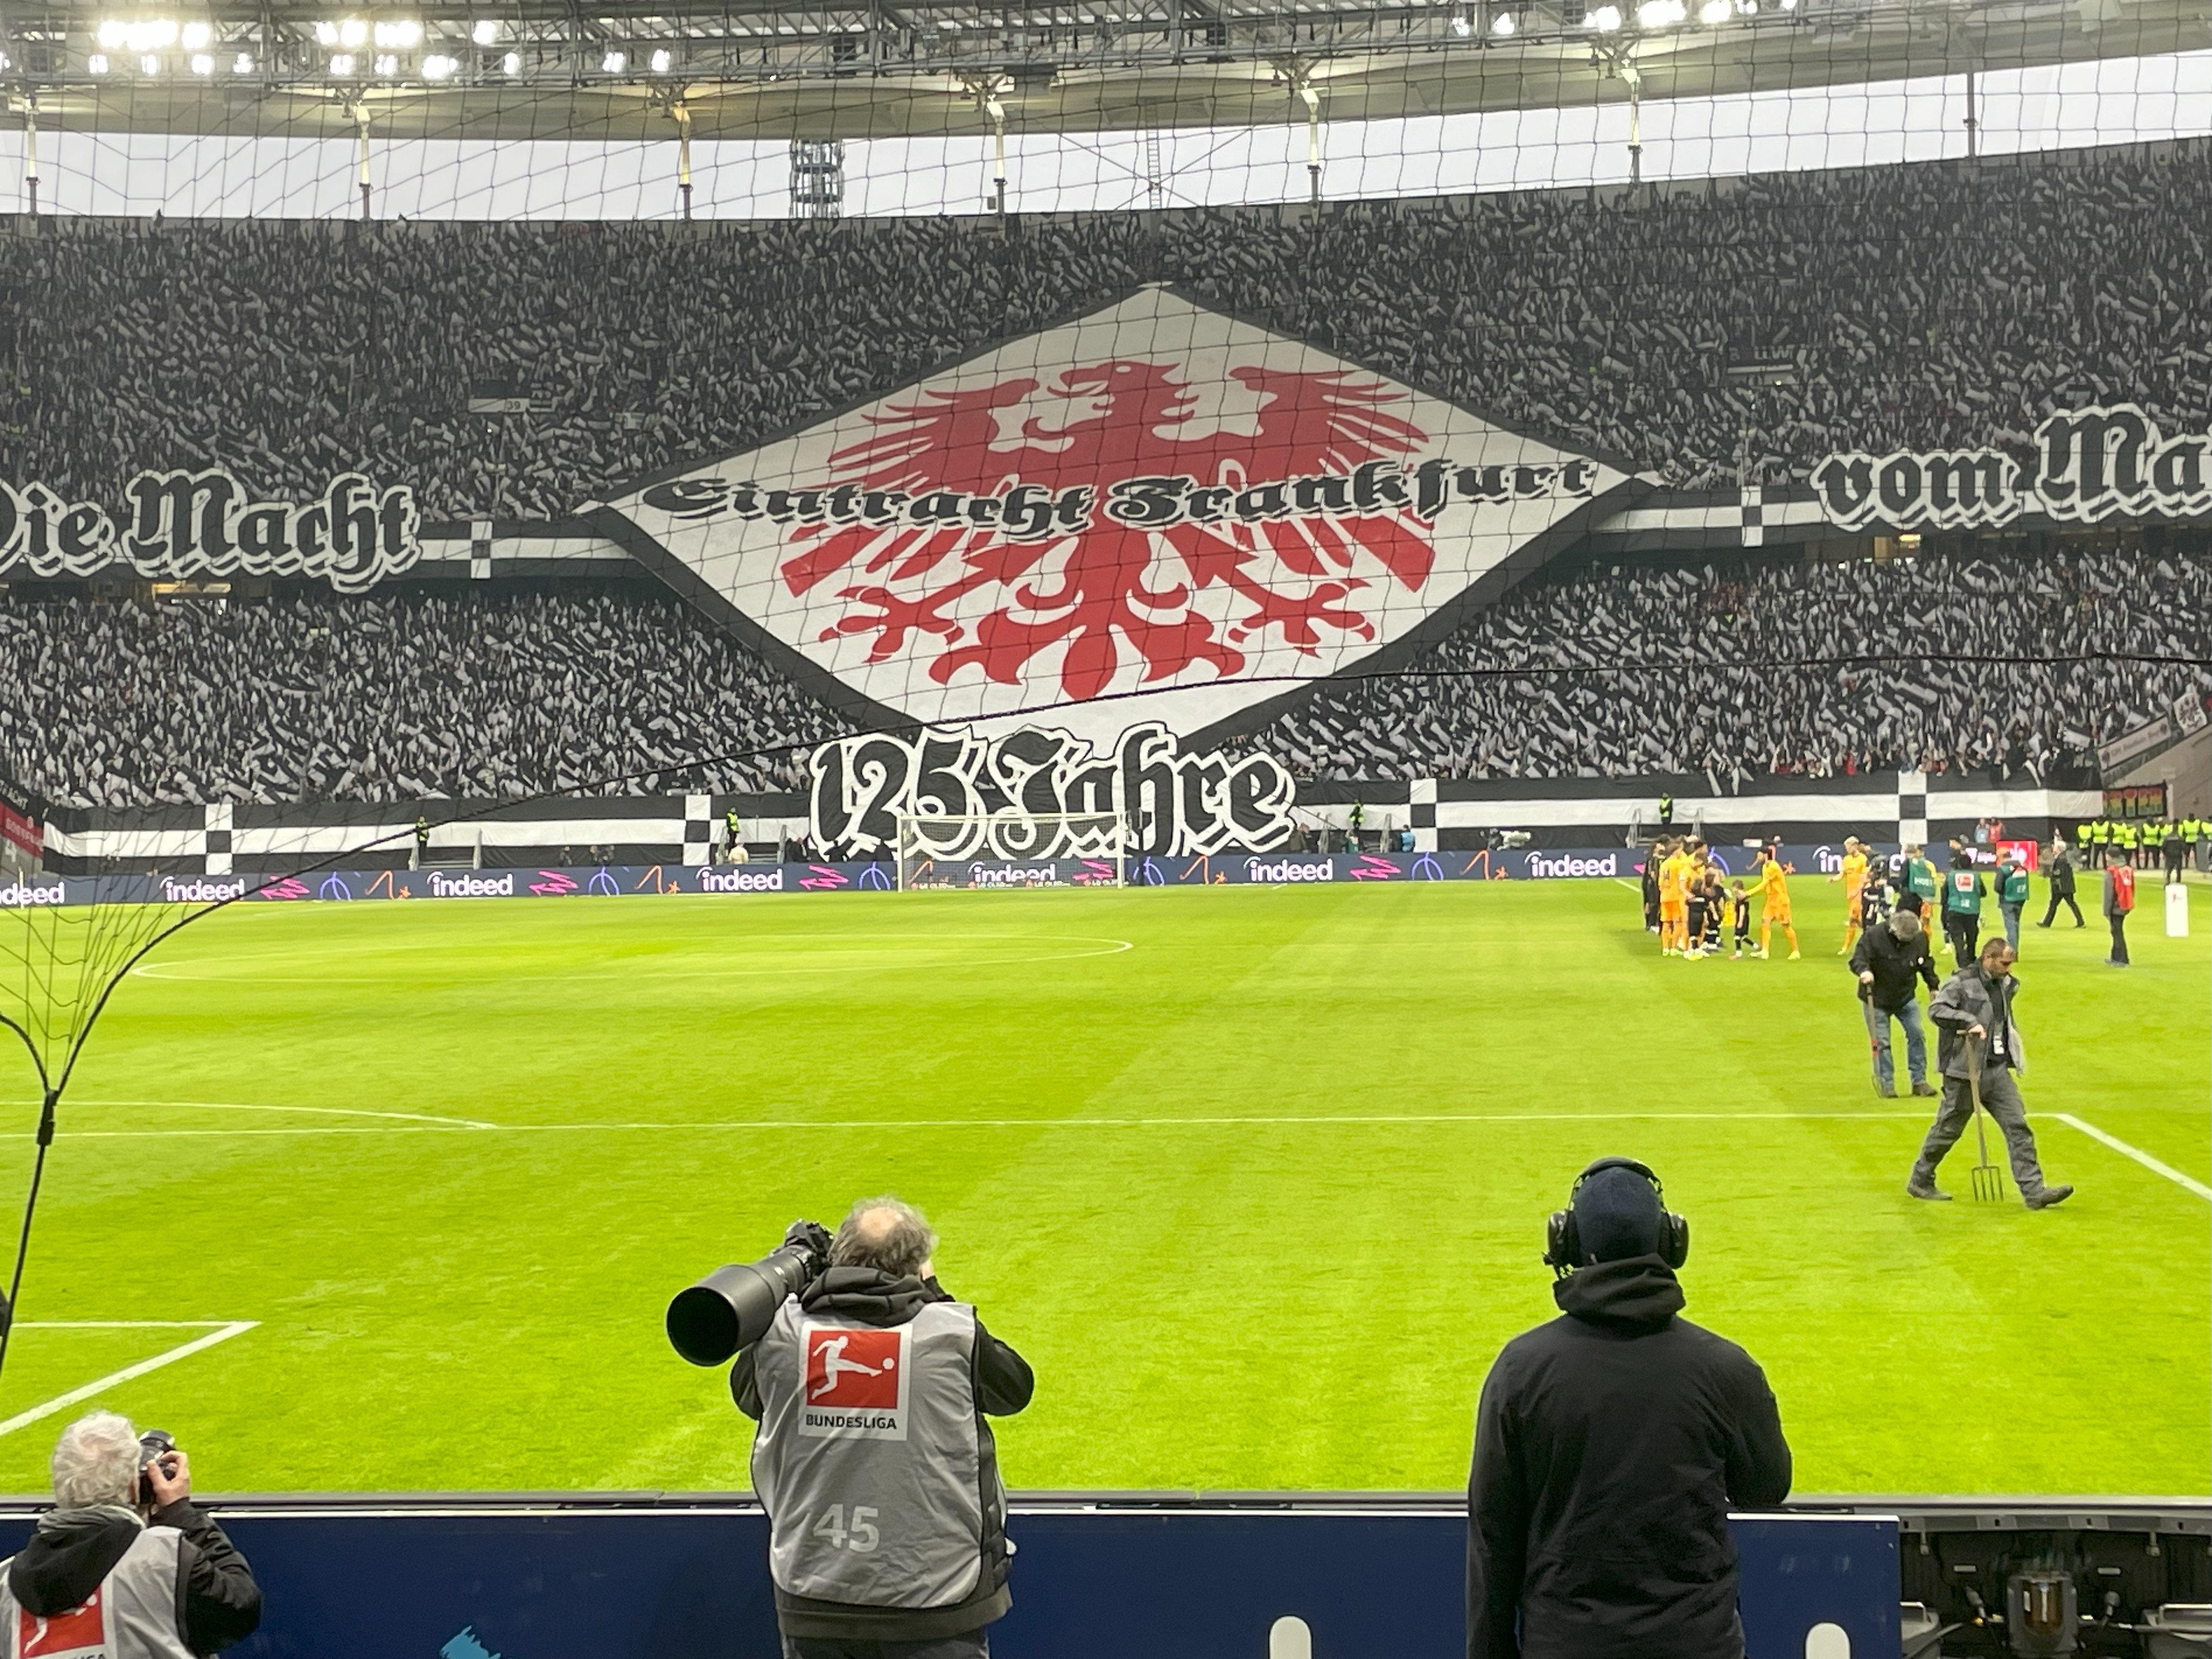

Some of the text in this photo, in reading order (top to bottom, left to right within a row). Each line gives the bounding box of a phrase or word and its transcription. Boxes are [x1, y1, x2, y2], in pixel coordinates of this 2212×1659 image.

[1810, 403, 2212, 532] vom Ma
[643, 459, 1598, 542] Eintracht Frankfurt
[122, 467, 421, 594] Macht
[809, 721, 1295, 862] 125 Jahre
[968, 861, 1056, 882] indeed
[1243, 856, 1333, 882] indeed
[1525, 851, 1616, 877] indeed
[160, 876, 245, 902] indeed
[427, 871, 513, 897] indeed
[696, 866, 782, 892] indeed
[806, 1414, 897, 1430] BUNDESLIGA
[813, 1503, 879, 1553] 45
